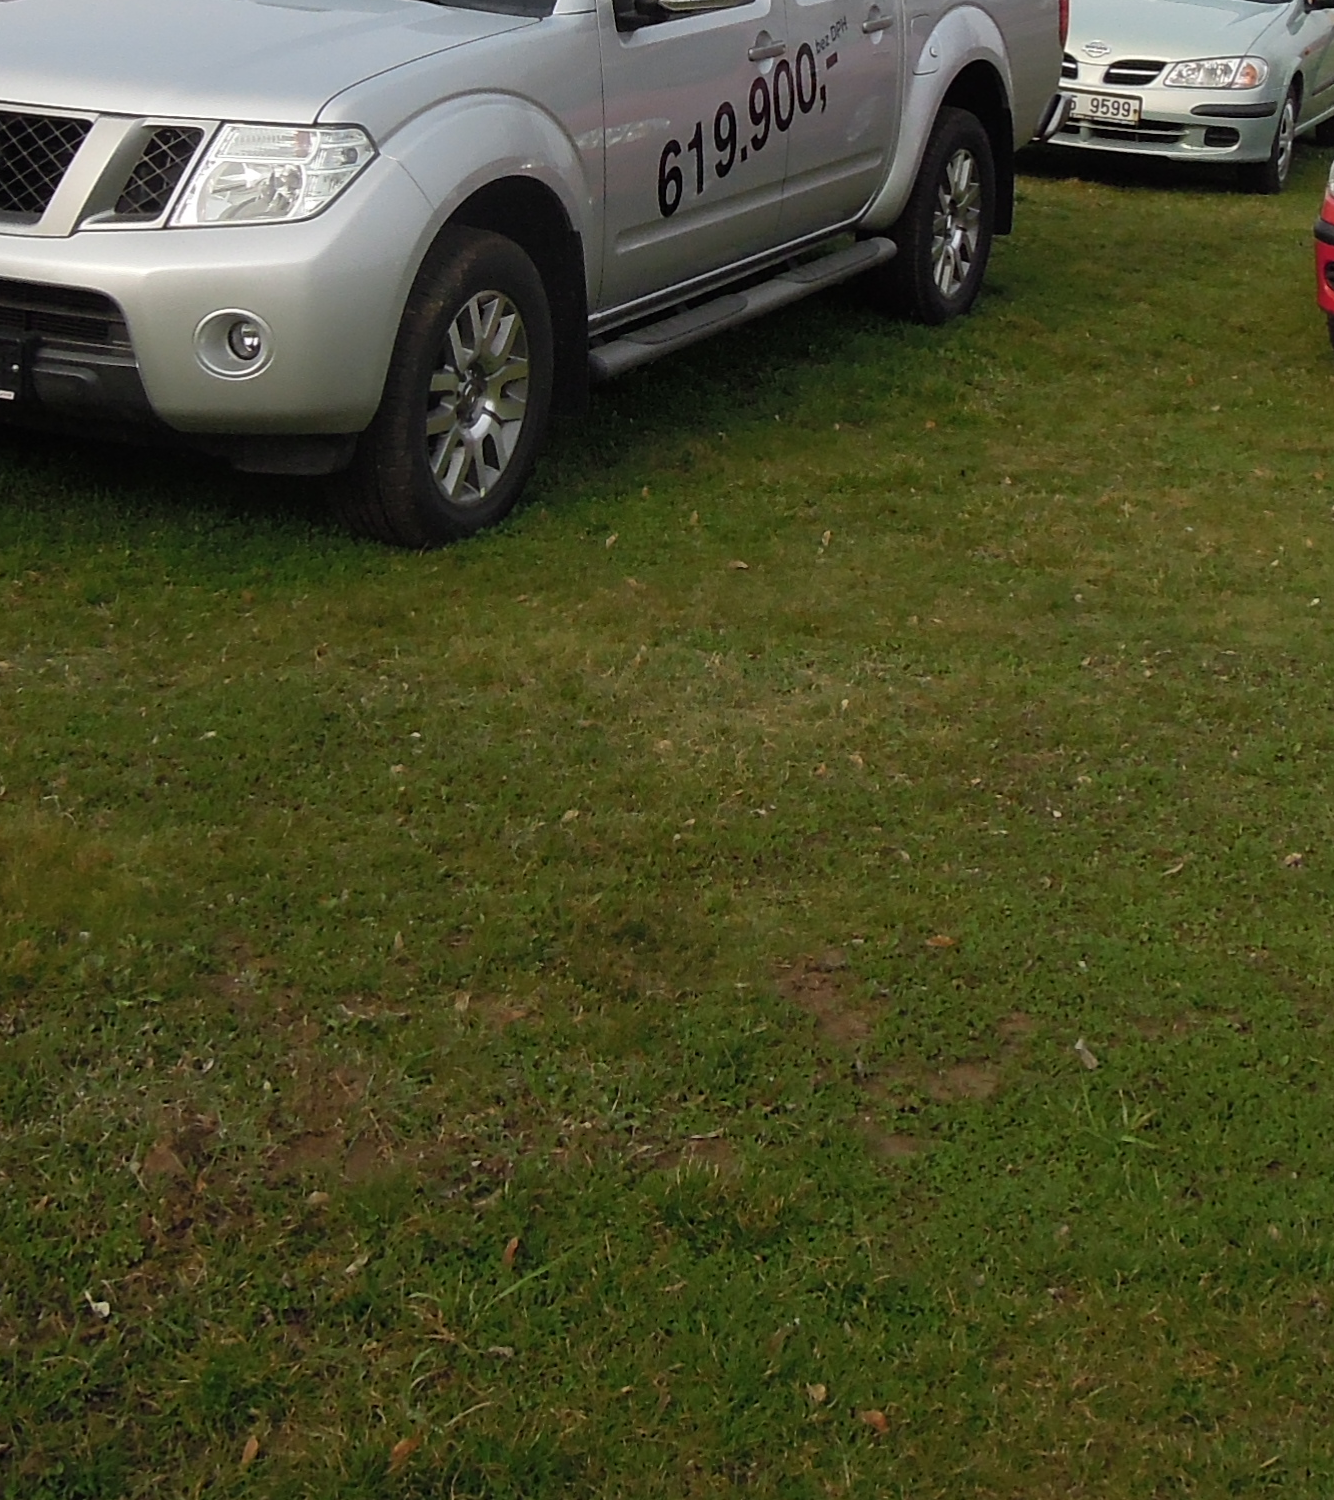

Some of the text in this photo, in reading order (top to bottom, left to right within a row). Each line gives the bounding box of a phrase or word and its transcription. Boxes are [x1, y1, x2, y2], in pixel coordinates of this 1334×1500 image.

[814, 15, 848, 54] bez DPH
[1089, 97, 1131, 118] 9599
[657, 42, 838, 218] 619.900,-
